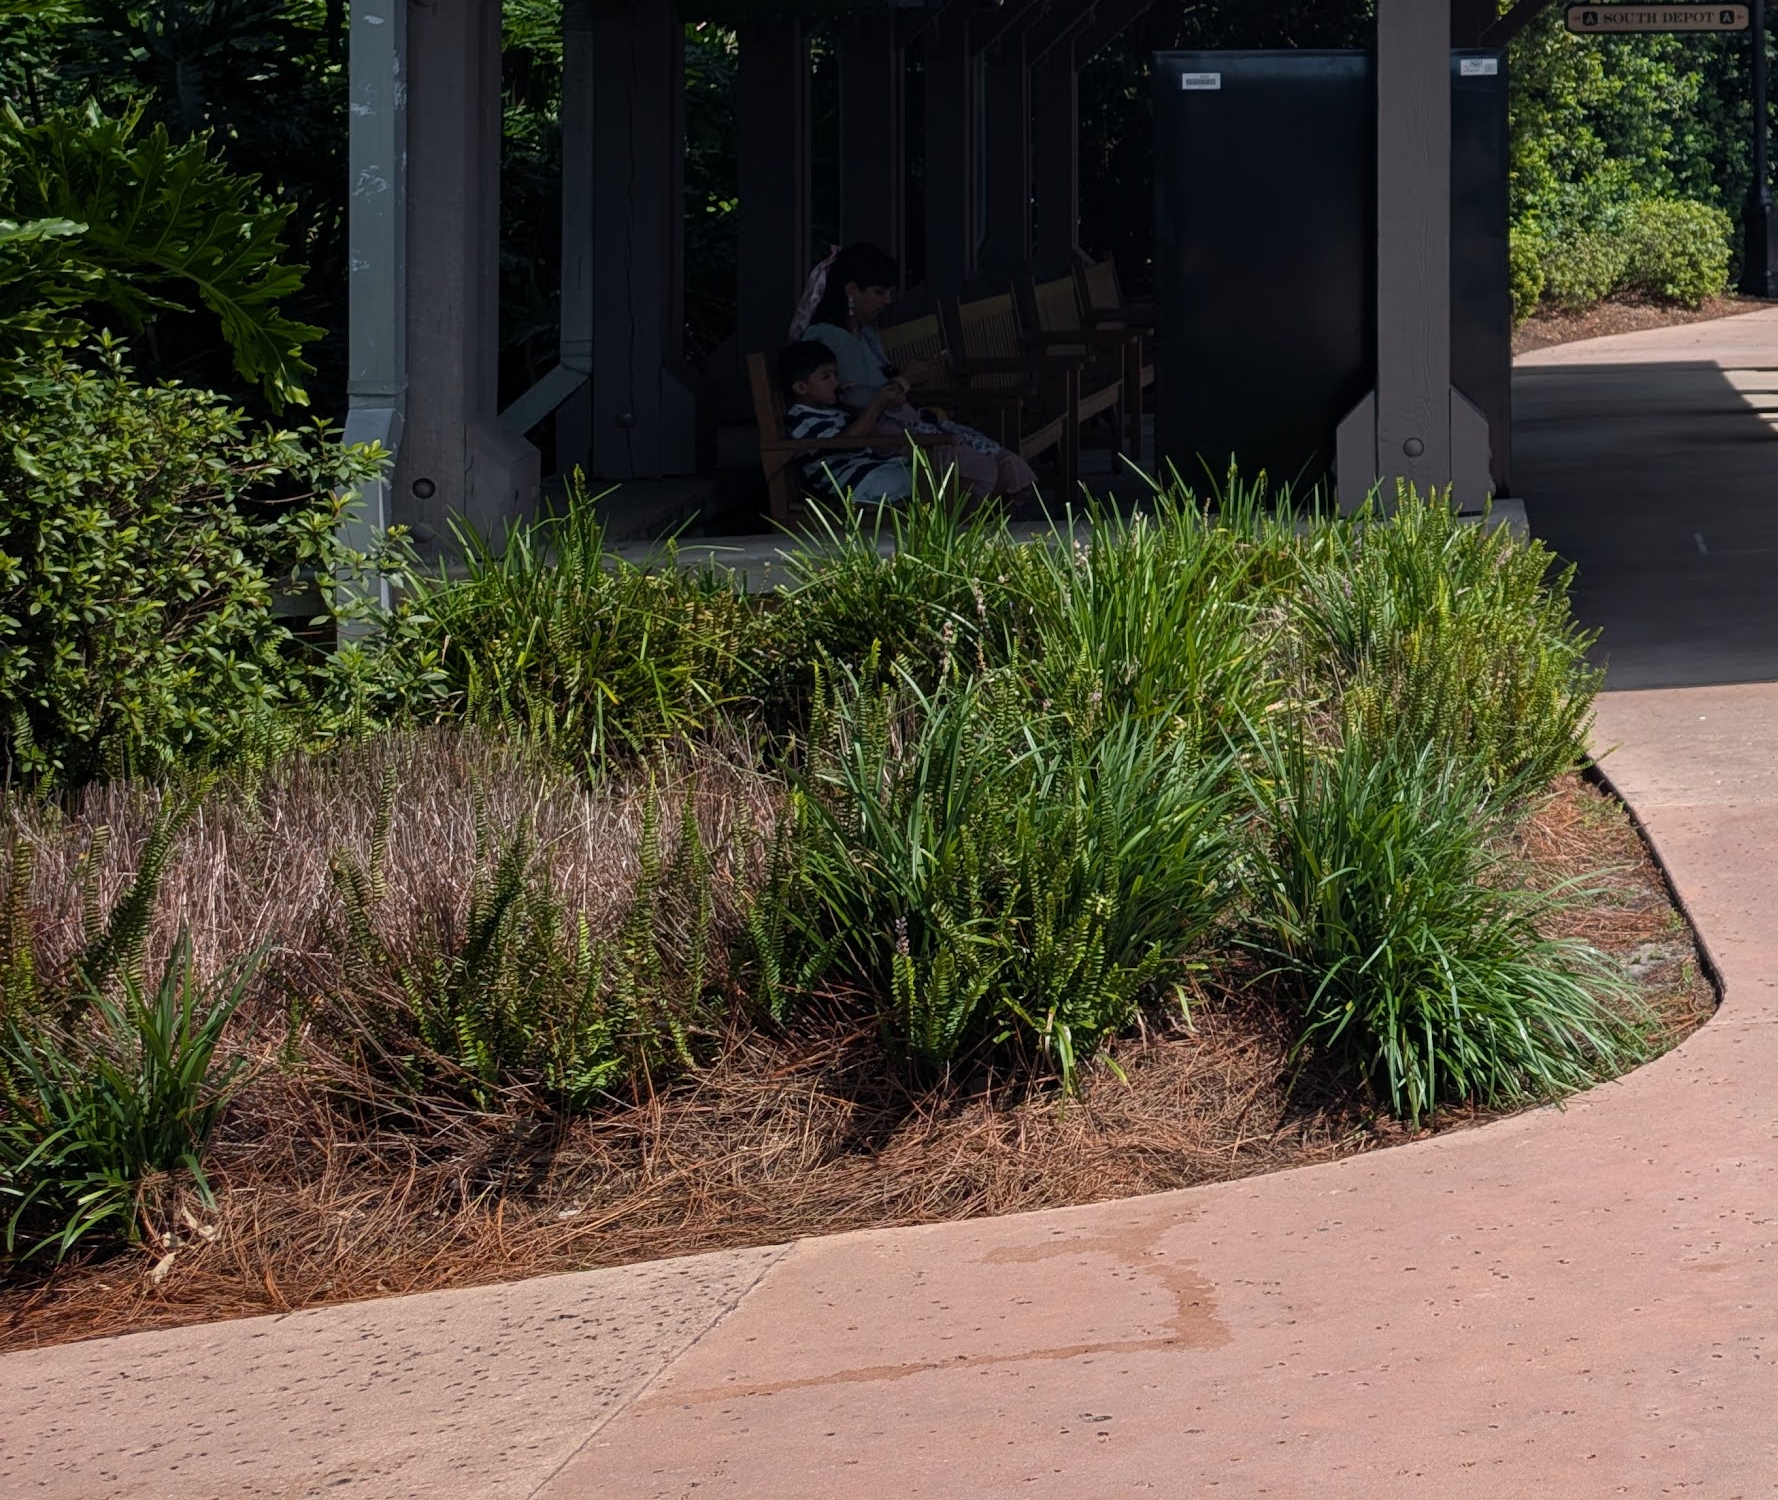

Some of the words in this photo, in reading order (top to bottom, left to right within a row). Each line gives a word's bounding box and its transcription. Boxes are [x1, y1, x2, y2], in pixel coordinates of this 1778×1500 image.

[1585, 11, 1596, 26] A
[1603, 11, 1657, 25] SOUTH
[1662, 11, 1715, 24] DEPOT
[1722, 10, 1733, 23] A
